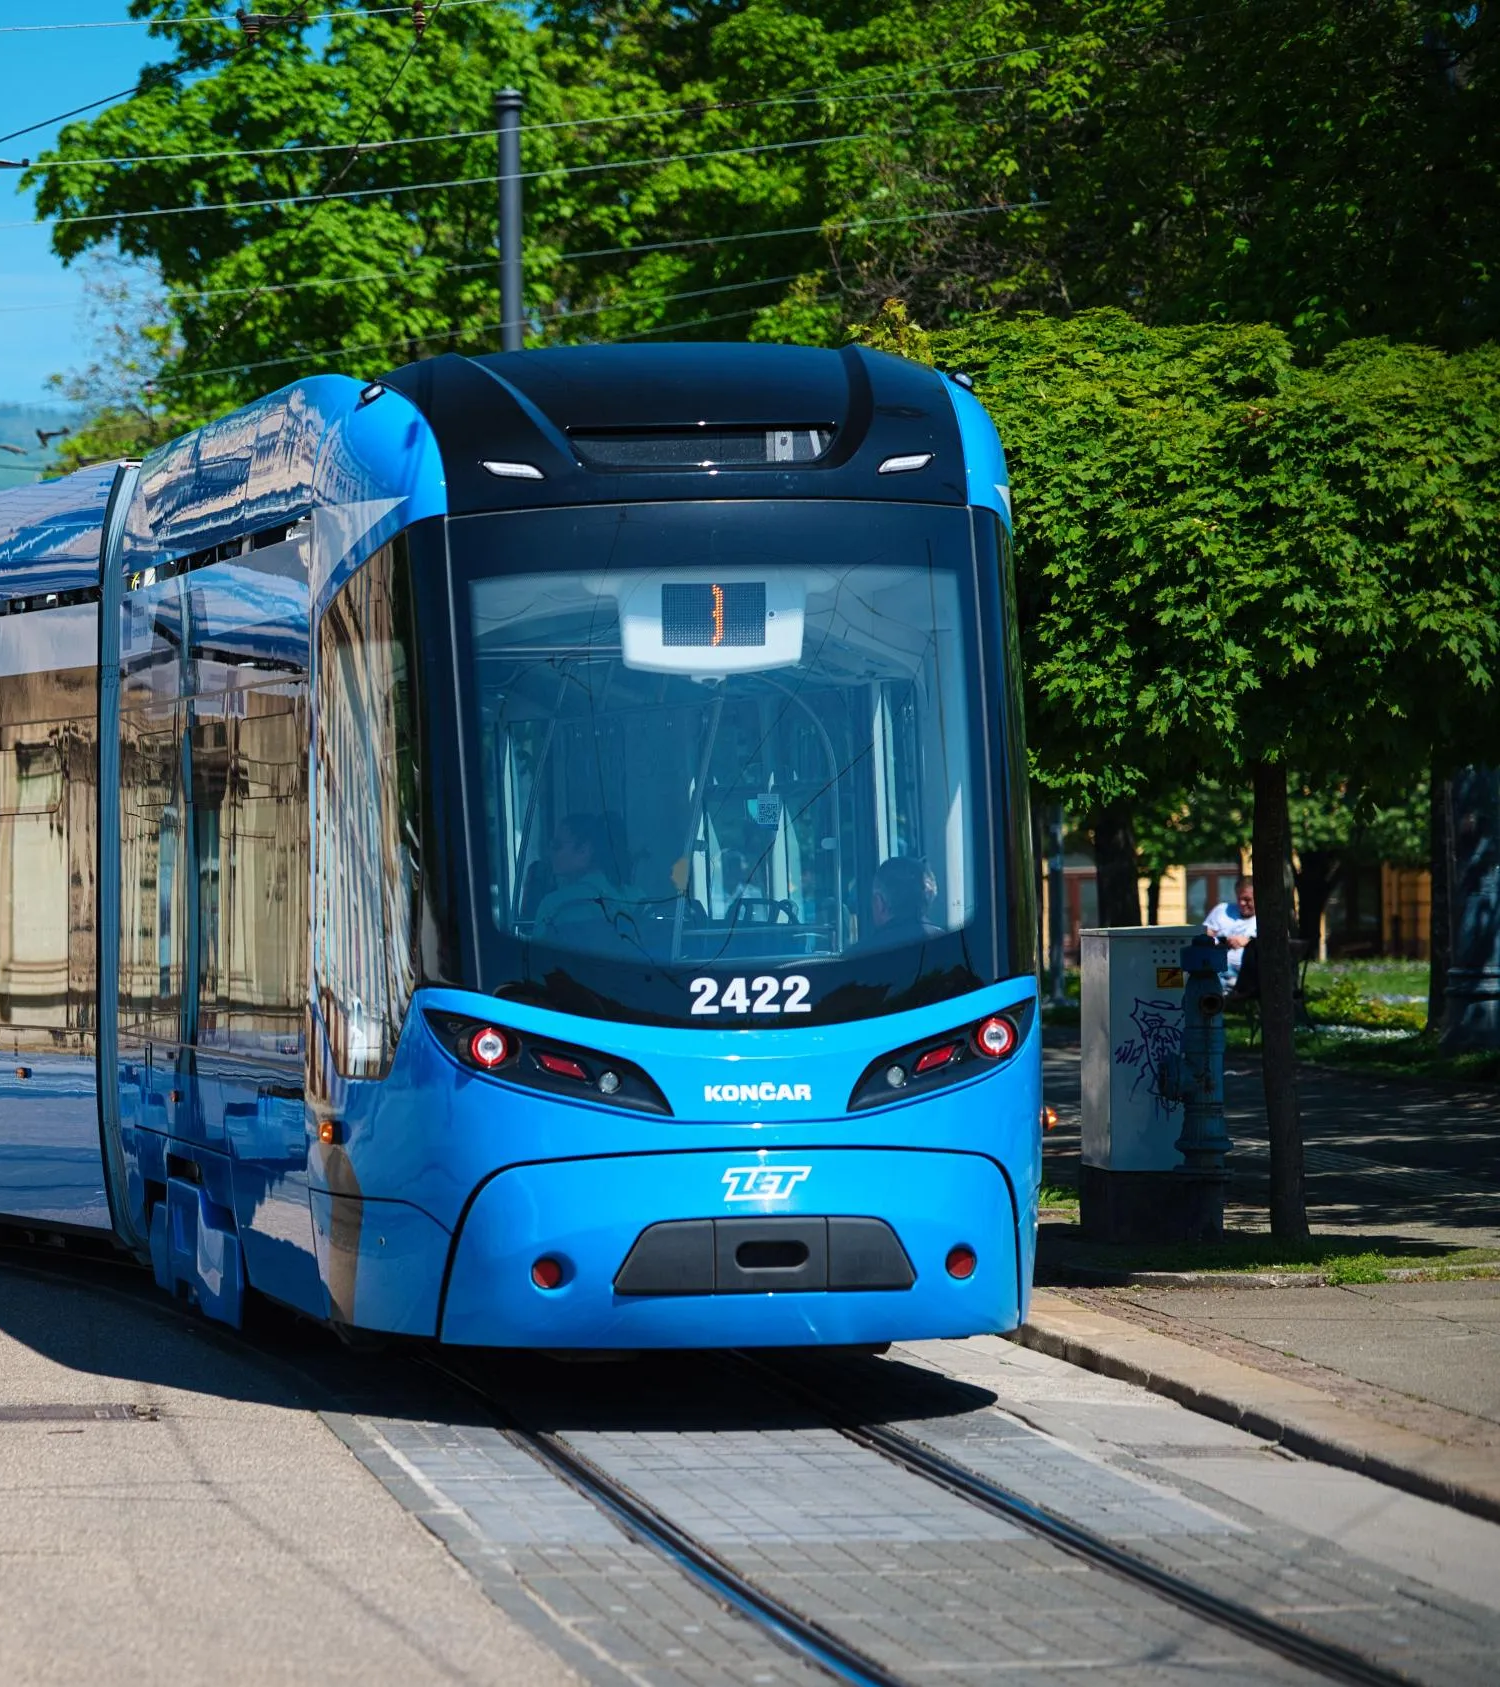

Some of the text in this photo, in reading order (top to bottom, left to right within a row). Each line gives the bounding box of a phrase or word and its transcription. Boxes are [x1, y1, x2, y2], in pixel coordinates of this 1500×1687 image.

[689, 975, 812, 1015] 2422
[703, 1082, 812, 1102] KONČAR
[720, 1165, 813, 1202] ZET
